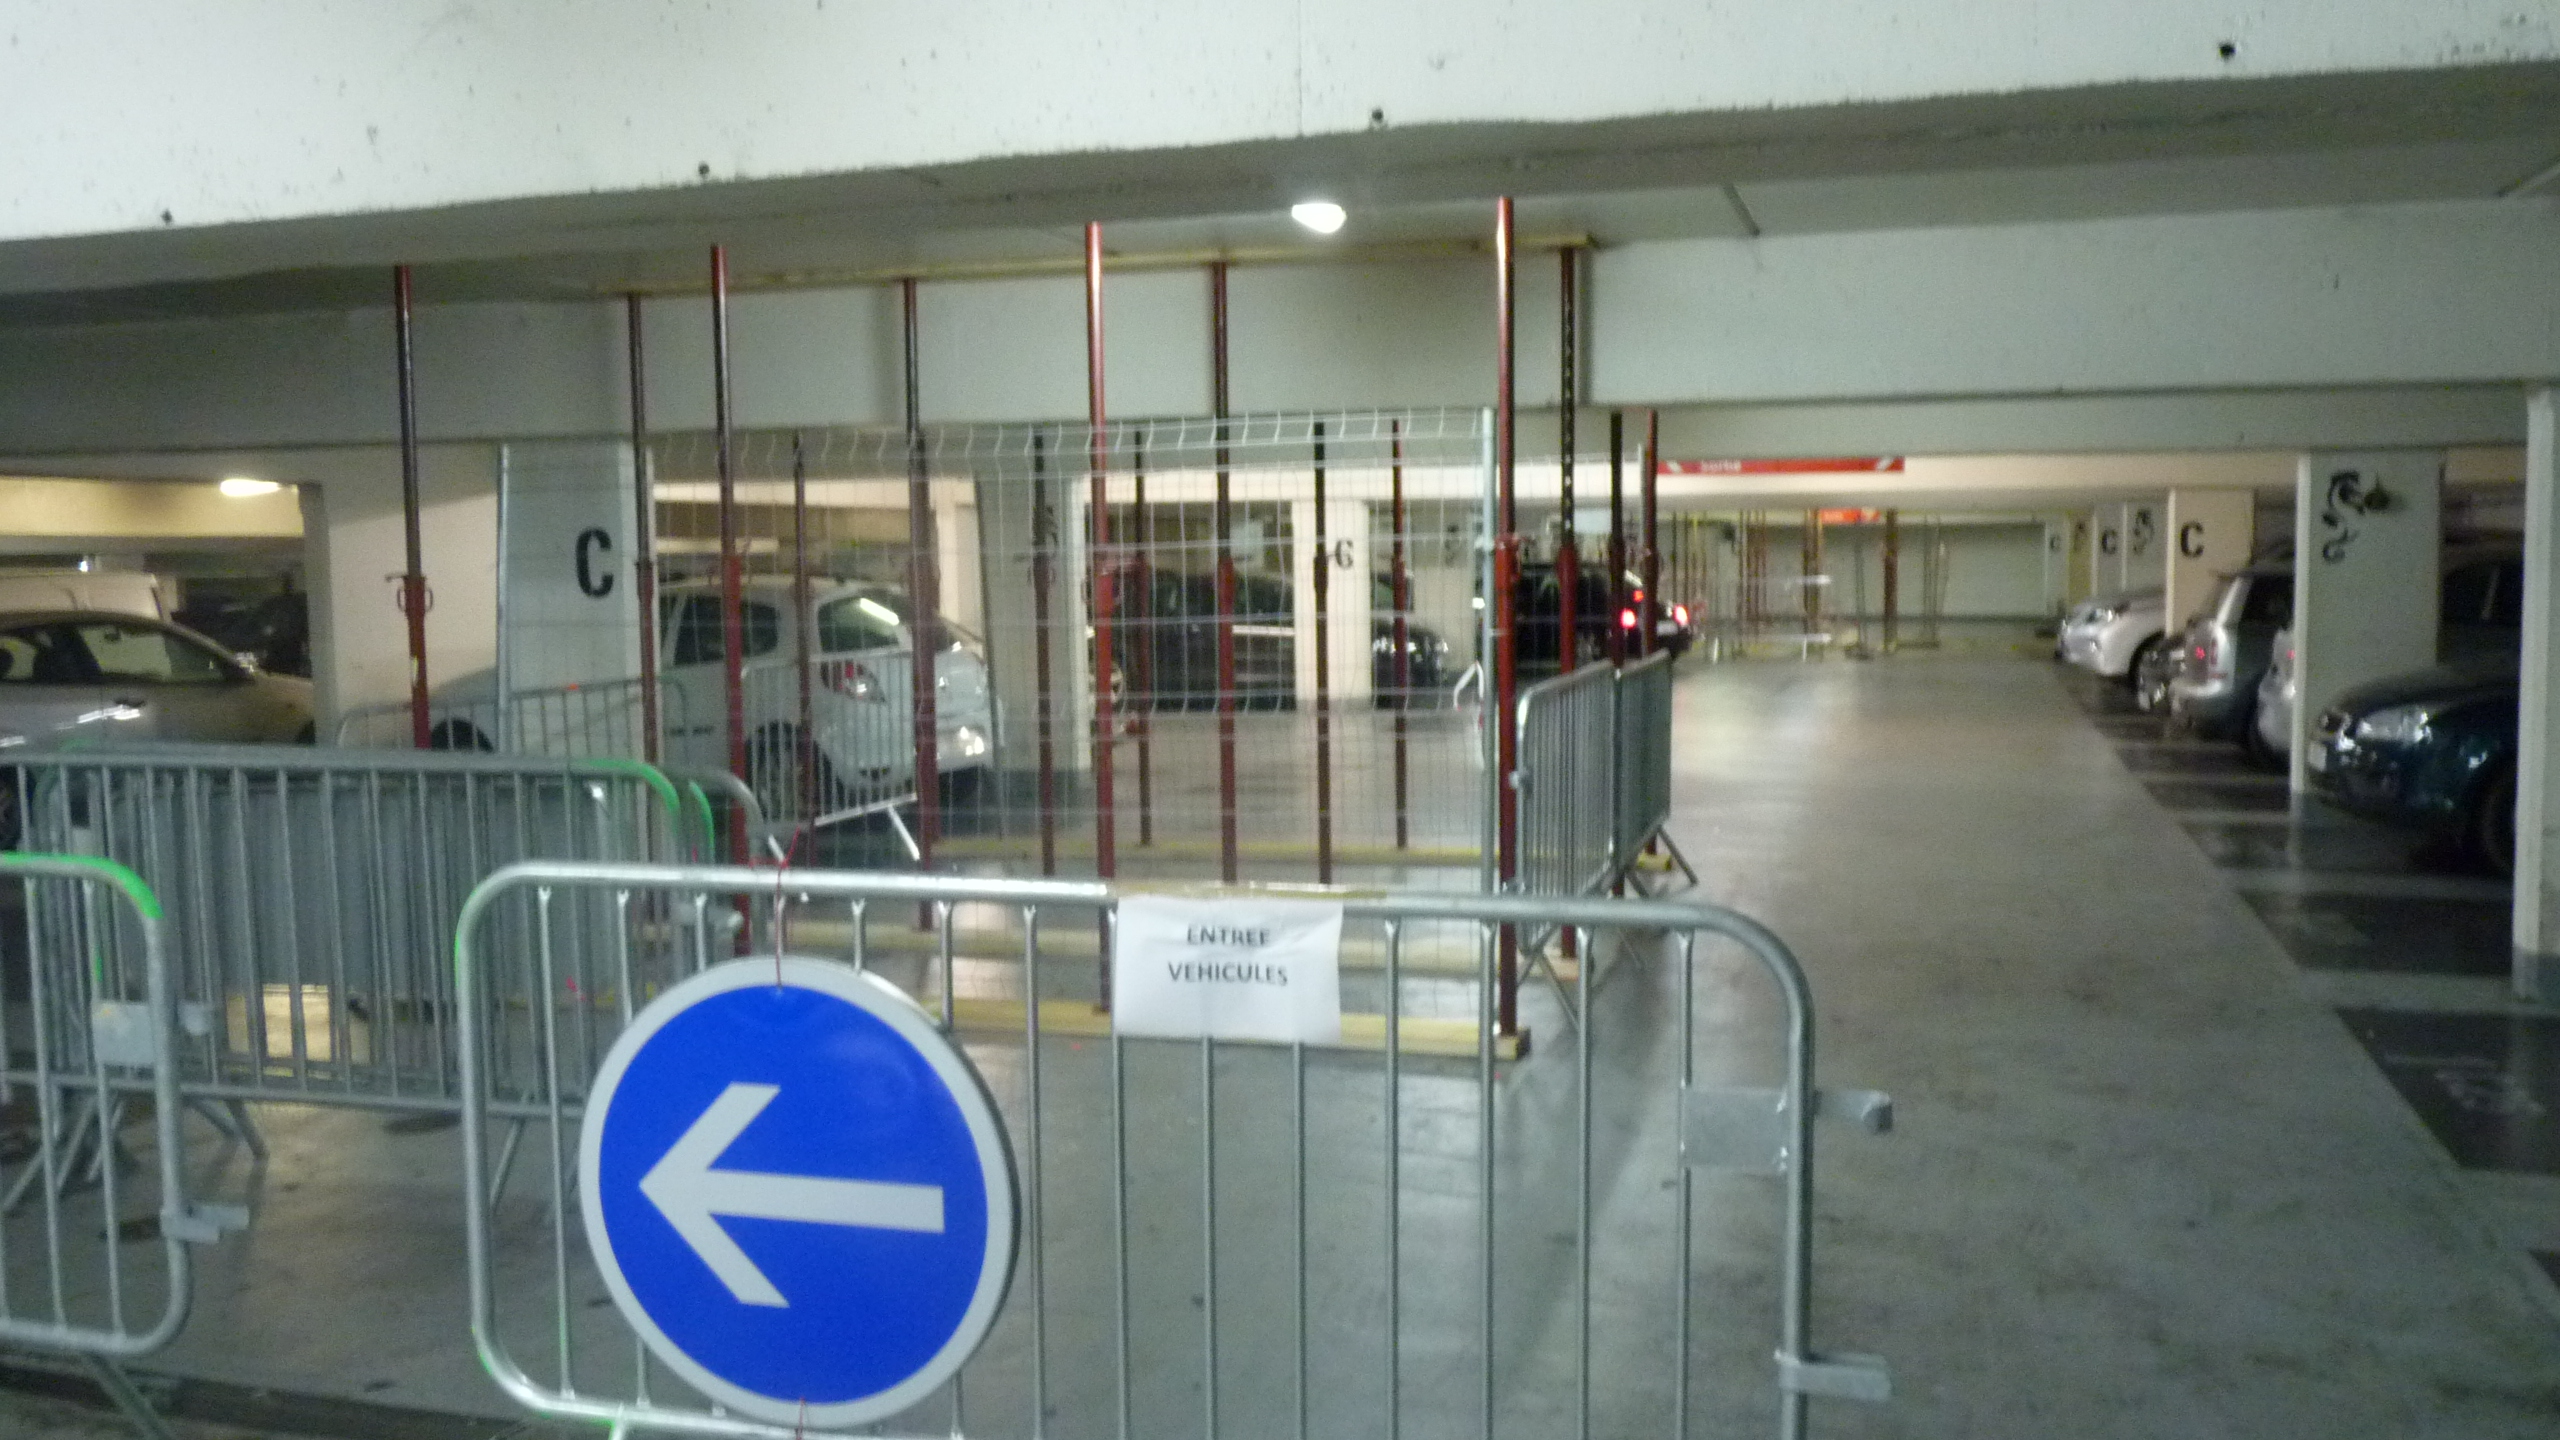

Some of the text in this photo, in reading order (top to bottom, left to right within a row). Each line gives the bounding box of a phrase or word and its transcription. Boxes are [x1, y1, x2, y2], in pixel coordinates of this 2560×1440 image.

[2180, 520, 2204, 557] C
[575, 526, 614, 598] C
[1186, 923, 1270, 947] ENTREE
[1168, 961, 1288, 986] VEHICULES
